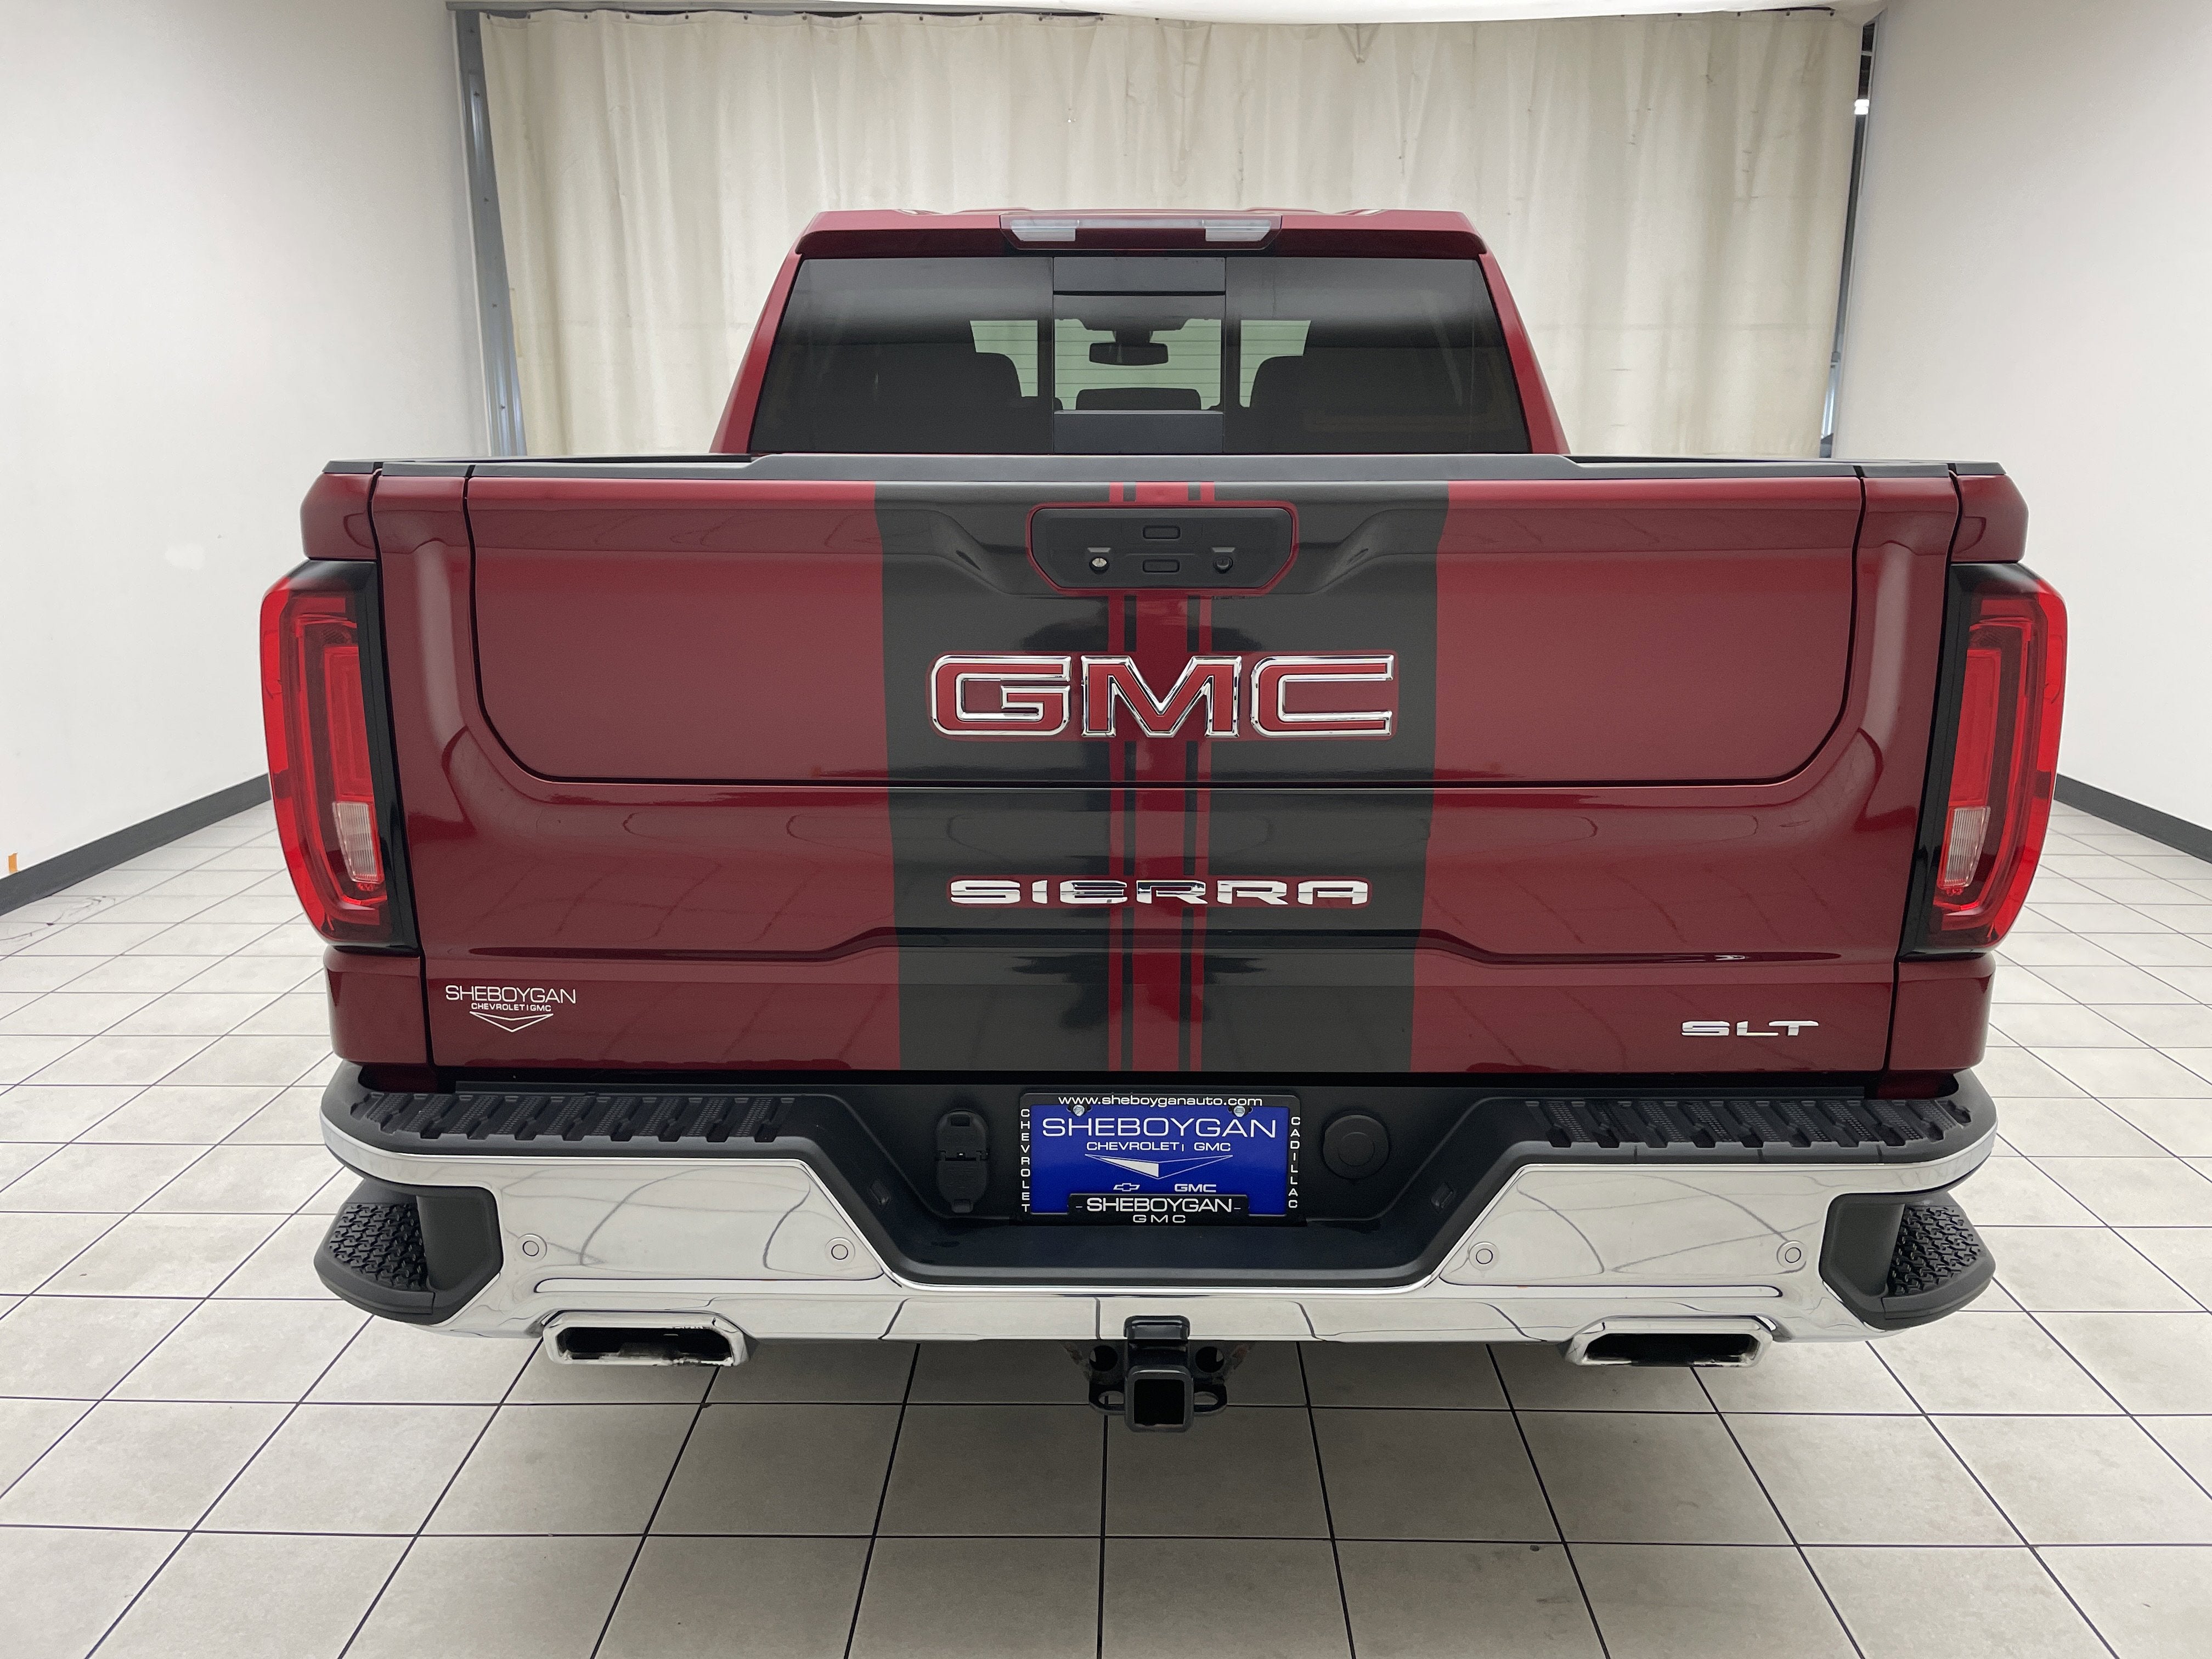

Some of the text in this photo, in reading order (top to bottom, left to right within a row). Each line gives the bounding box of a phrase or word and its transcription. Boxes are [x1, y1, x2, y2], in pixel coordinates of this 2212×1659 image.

[931, 654, 1394, 738] GMC
[950, 879, 1369, 905] SIERRA
[445, 985, 576, 1004] SHEBOYGAN
[471, 1002, 525, 1011] CHEVROLET
[1681, 1020, 1819, 1036] SLT
[1058, 1094, 1262, 1108] www.sheboyganauto.com
[1042, 1118, 1276, 1138] SHEBOYGAN
[1086, 1141, 1231, 1152] CHEVROLET GMC
[1020, 1109, 1031, 1212] CHEVROLET
[1288, 1116, 1301, 1208] CADILLAC
[1174, 1183, 1217, 1193] GMC
[1087, 1197, 1232, 1212] SHEBOYGAN
[1132, 1214, 1186, 1223] GMC
